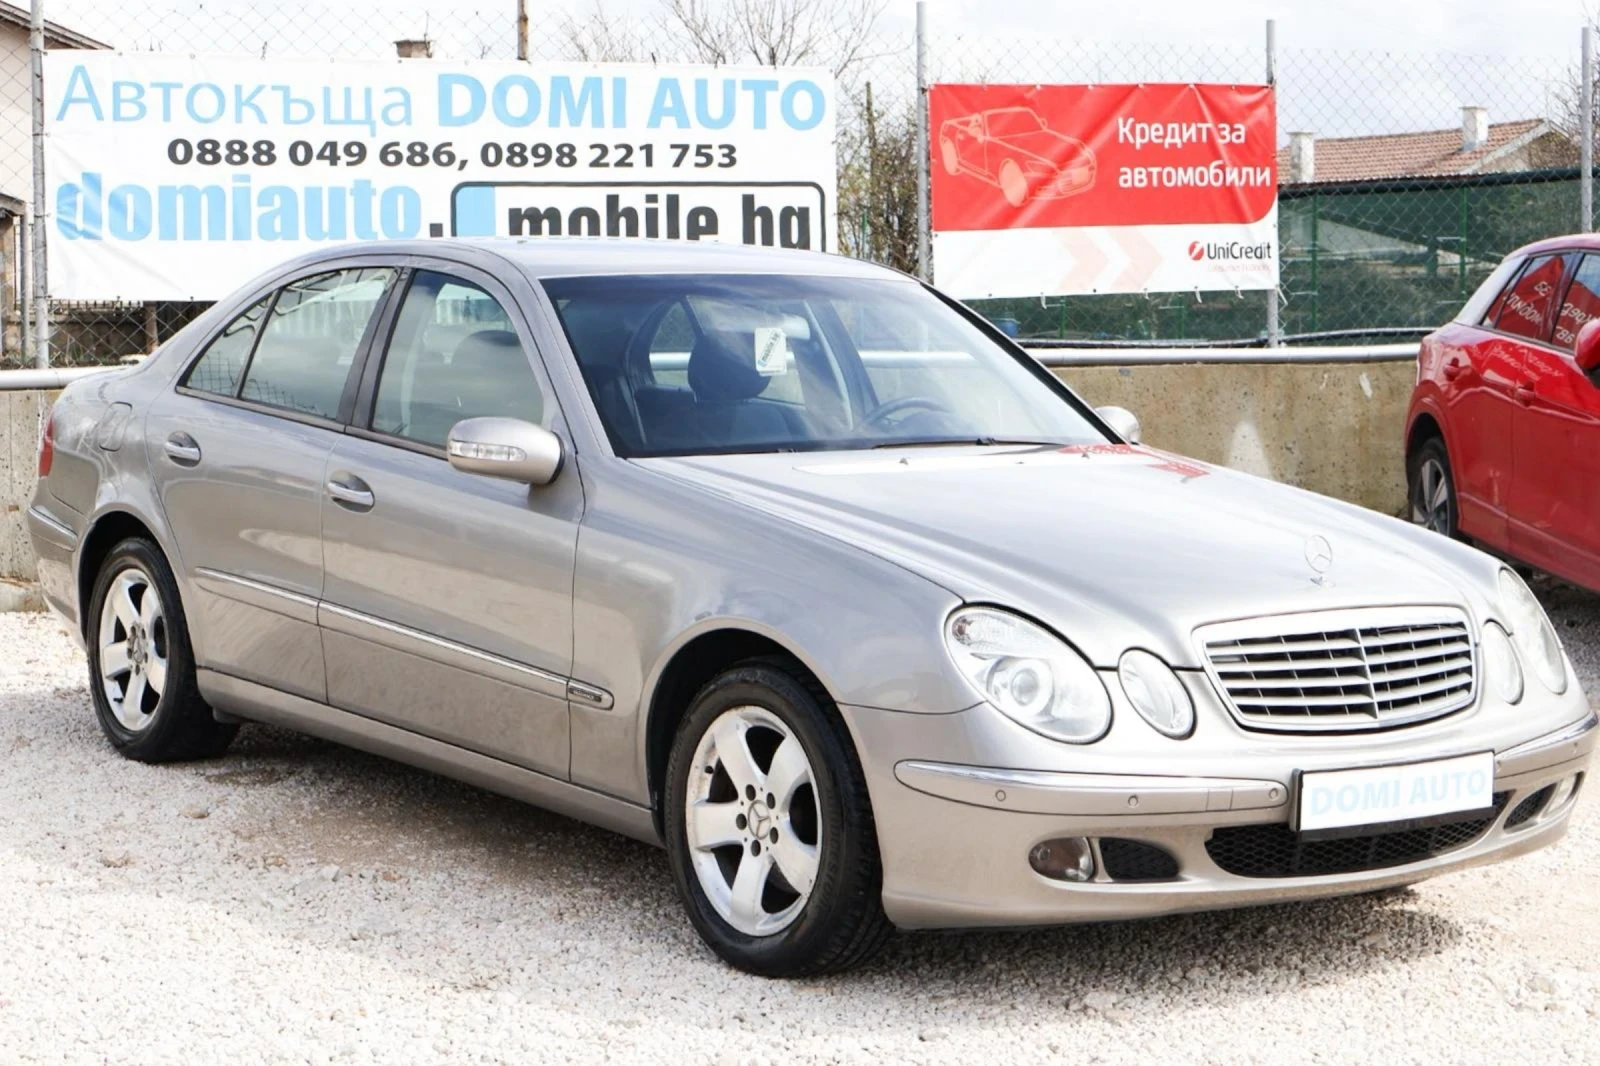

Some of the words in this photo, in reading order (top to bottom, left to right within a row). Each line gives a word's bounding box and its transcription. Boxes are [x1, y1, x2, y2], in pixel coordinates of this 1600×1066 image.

[56, 64, 412, 136] Автокъща
[437, 73, 627, 128] DOMI
[647, 77, 826, 131] AUTO
[1118, 117, 1211, 147] Кредит
[1218, 124, 1246, 144] за
[168, 139, 276, 165] 0888
[289, 141, 366, 166] 049
[380, 142, 467, 170] 686,
[481, 143, 576, 167] 0898
[590, 144, 652, 167] 221
[671, 145, 736, 167] 753
[1119, 161, 1270, 187] автомобили
[1207, 242, 1272, 260] UniCredit
[1311, 780, 1400, 816] DOMI
[1409, 769, 1487, 805] AUTO
